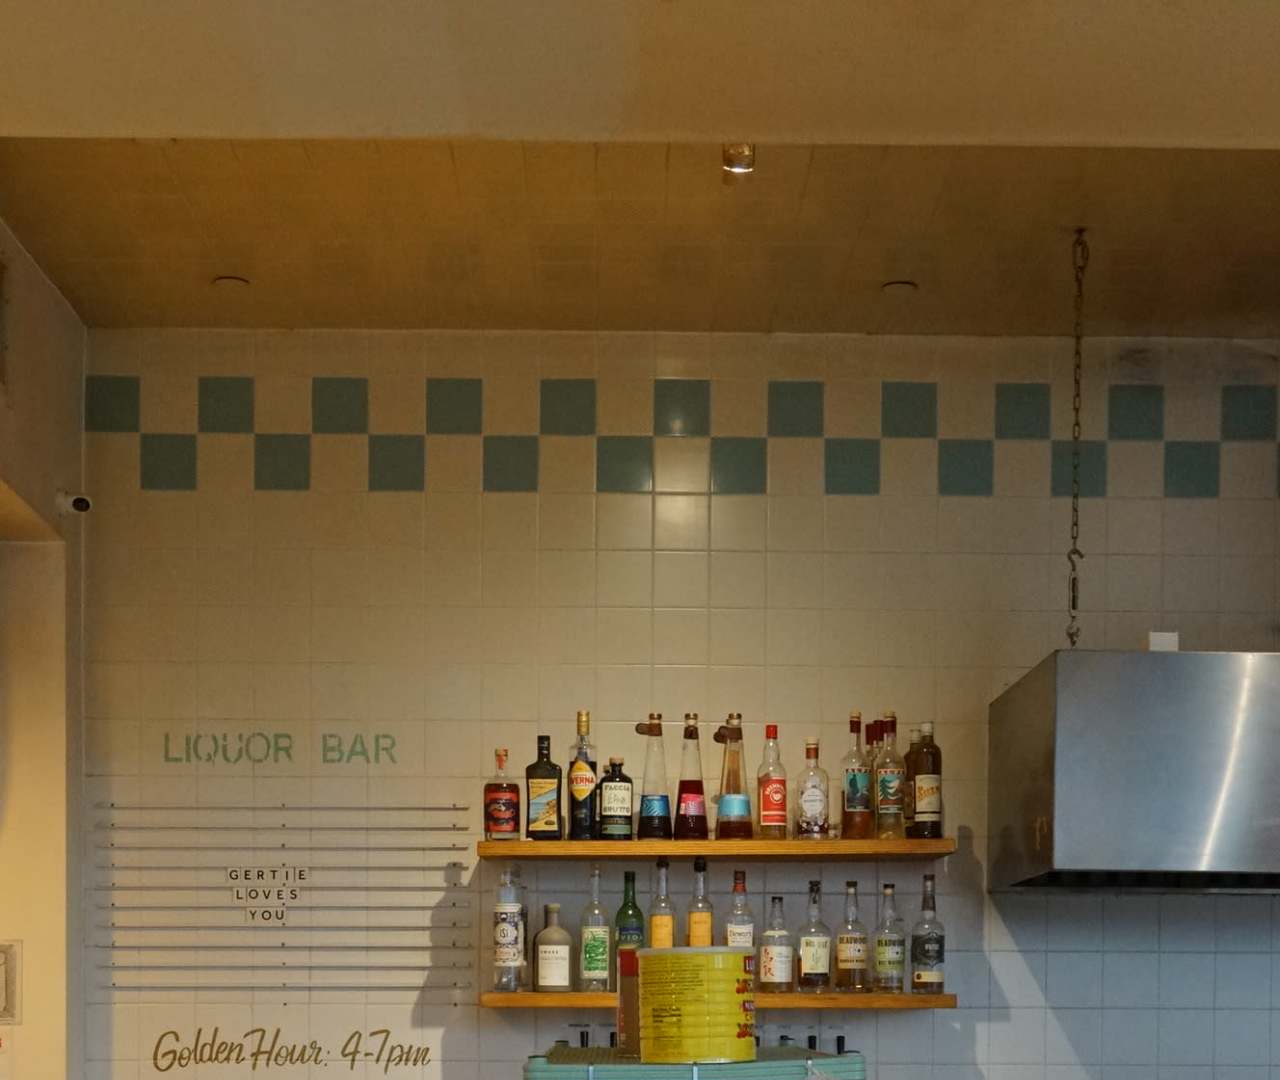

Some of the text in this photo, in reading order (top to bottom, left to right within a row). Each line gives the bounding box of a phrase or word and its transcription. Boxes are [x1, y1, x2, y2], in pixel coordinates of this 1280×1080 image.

[162, 731, 398, 764] LIQUOR BAR
[228, 868, 308, 881] GERTIE
[235, 888, 299, 900] LOVES
[249, 910, 286, 921] YOU
[152, 1026, 431, 1074] Golden Hour: 4-7pm
